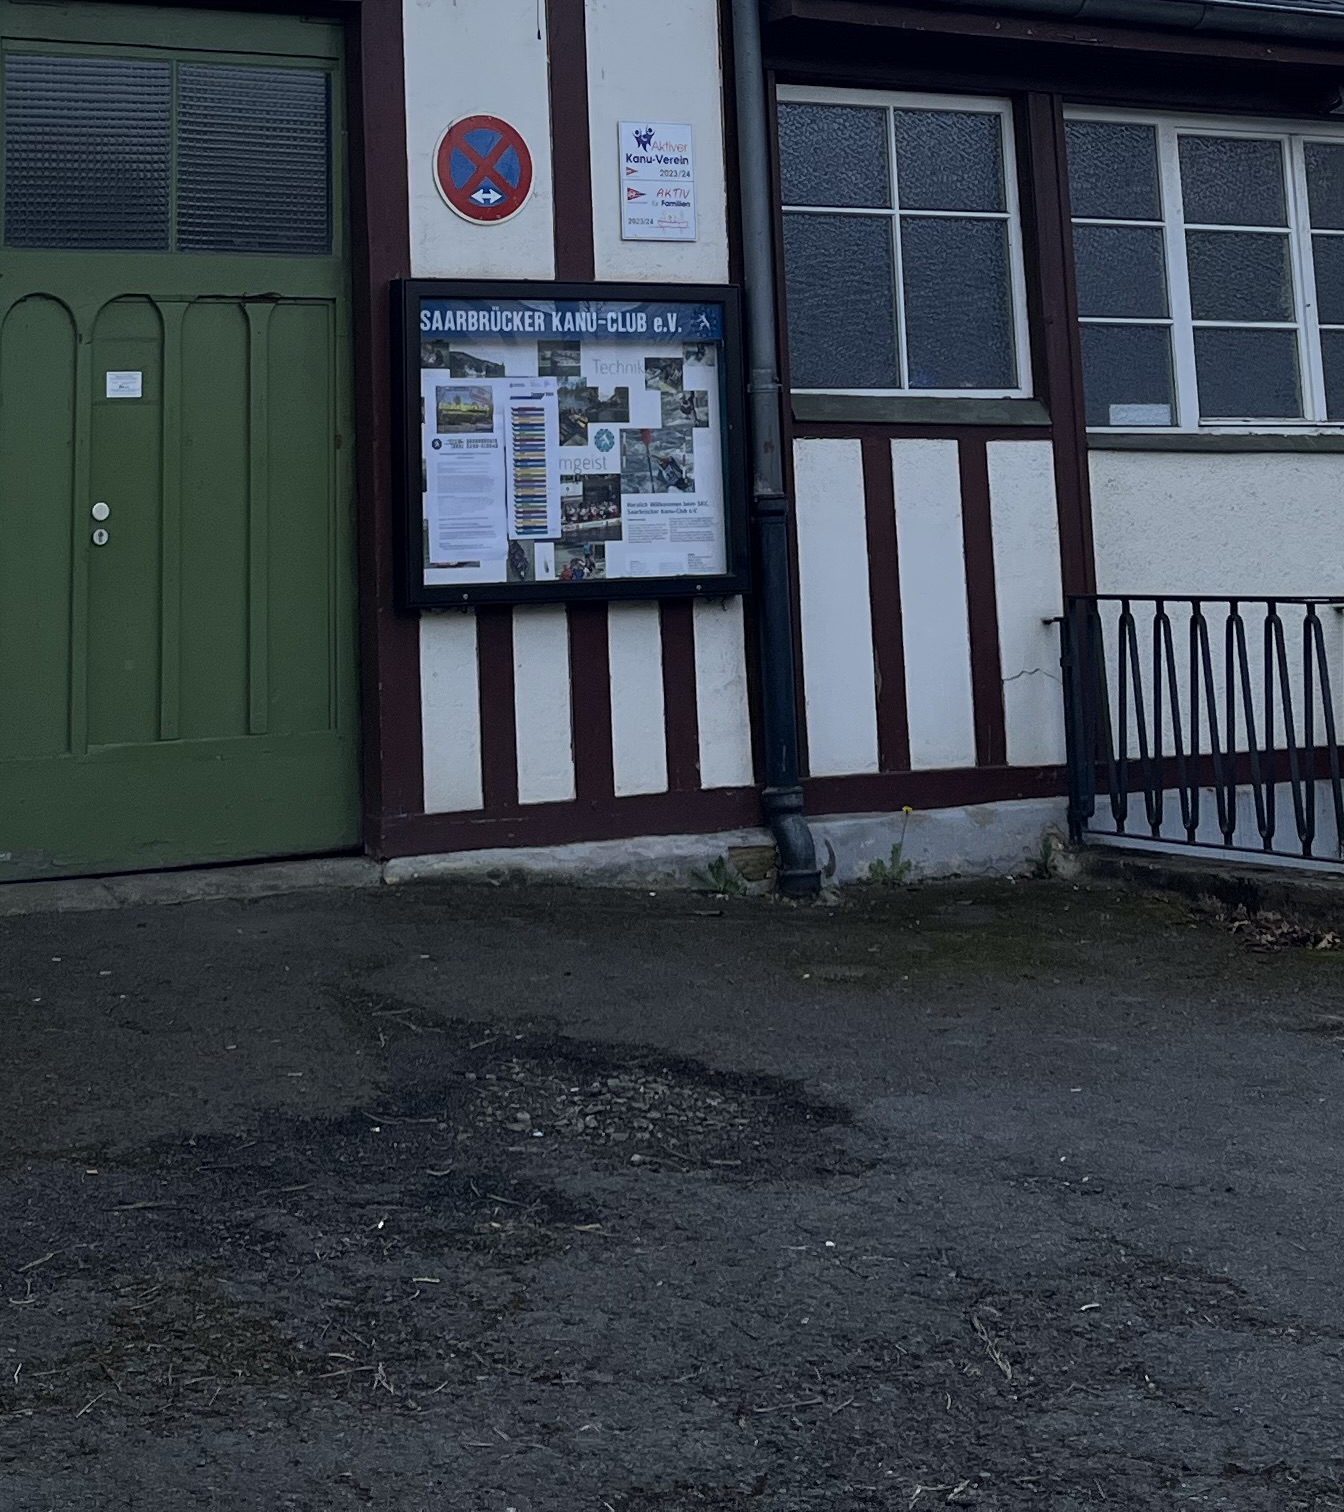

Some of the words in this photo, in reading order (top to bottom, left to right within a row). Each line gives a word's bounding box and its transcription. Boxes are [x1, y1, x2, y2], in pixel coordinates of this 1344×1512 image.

[651, 140, 688, 153] Aktiver
[625, 153, 689, 166] Kanu-Verein
[659, 168, 691, 178] 2023/24
[656, 187, 691, 200] AKTIV
[661, 199, 691, 208] Familien
[628, 217, 654, 225] 2023/24
[420, 306, 546, 332] SAARBRÜCKER
[552, 311, 647, 333] KANU-CLUB
[653, 312, 683, 333] e.V.
[591, 358, 645, 375] Technik
